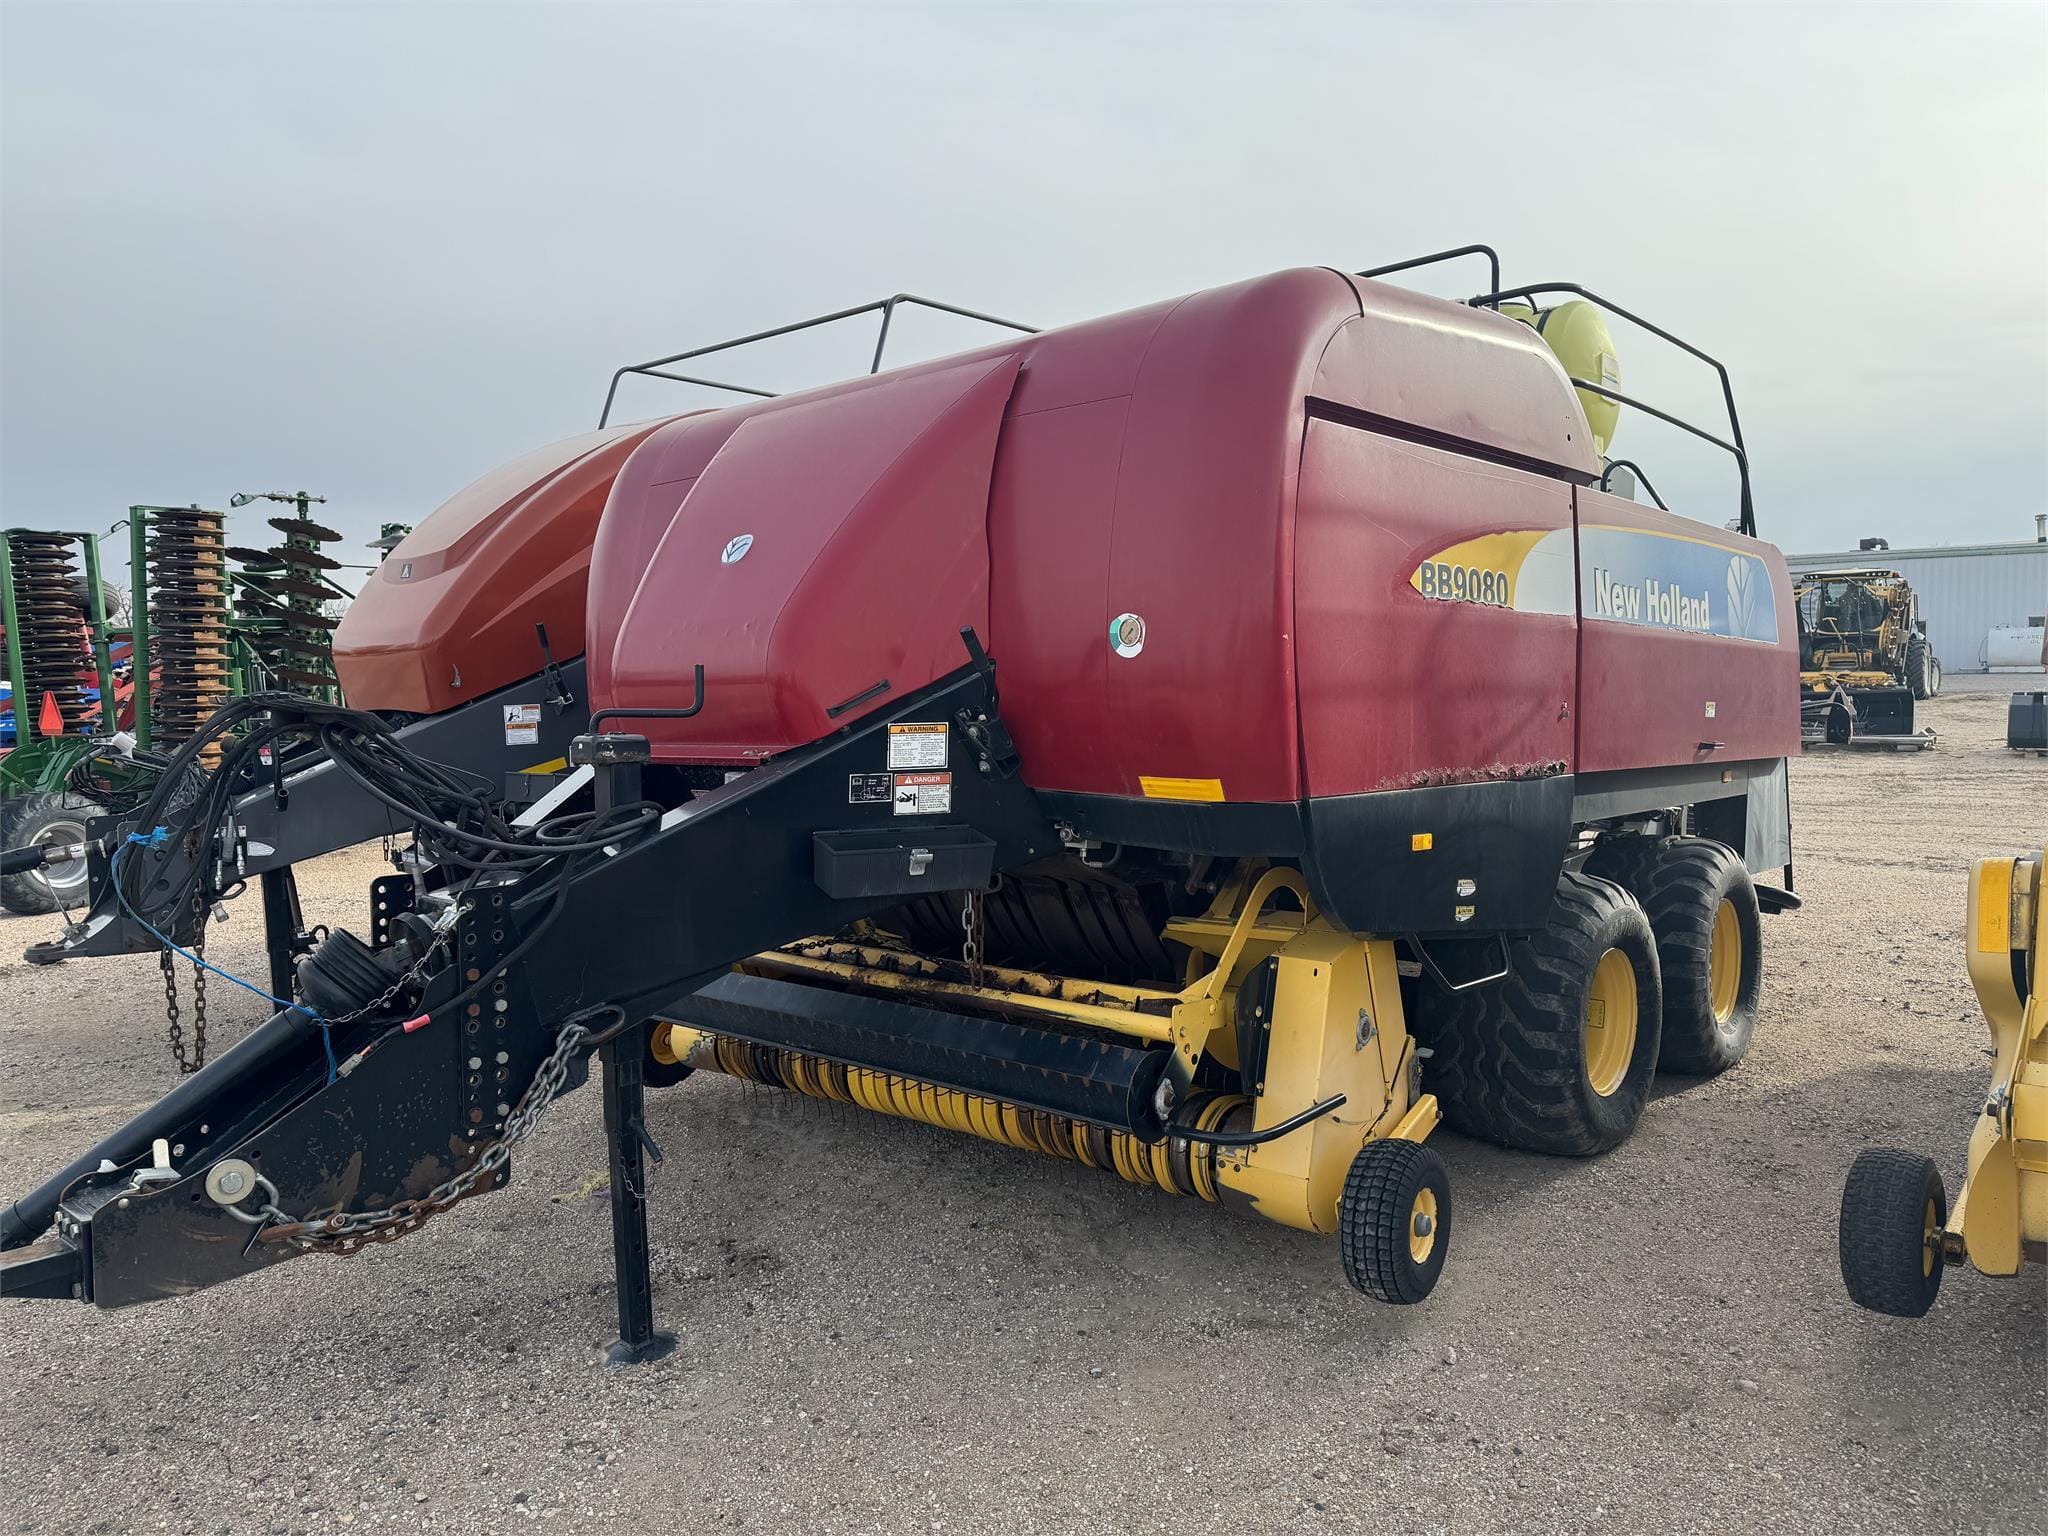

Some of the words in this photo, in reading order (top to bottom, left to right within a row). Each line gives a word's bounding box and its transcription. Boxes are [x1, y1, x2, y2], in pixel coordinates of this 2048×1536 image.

[1420, 560, 1509, 606] BB9080
[1594, 568, 1641, 620] New
[1645, 577, 1710, 630] Holland
[907, 725, 939, 733] WARNING
